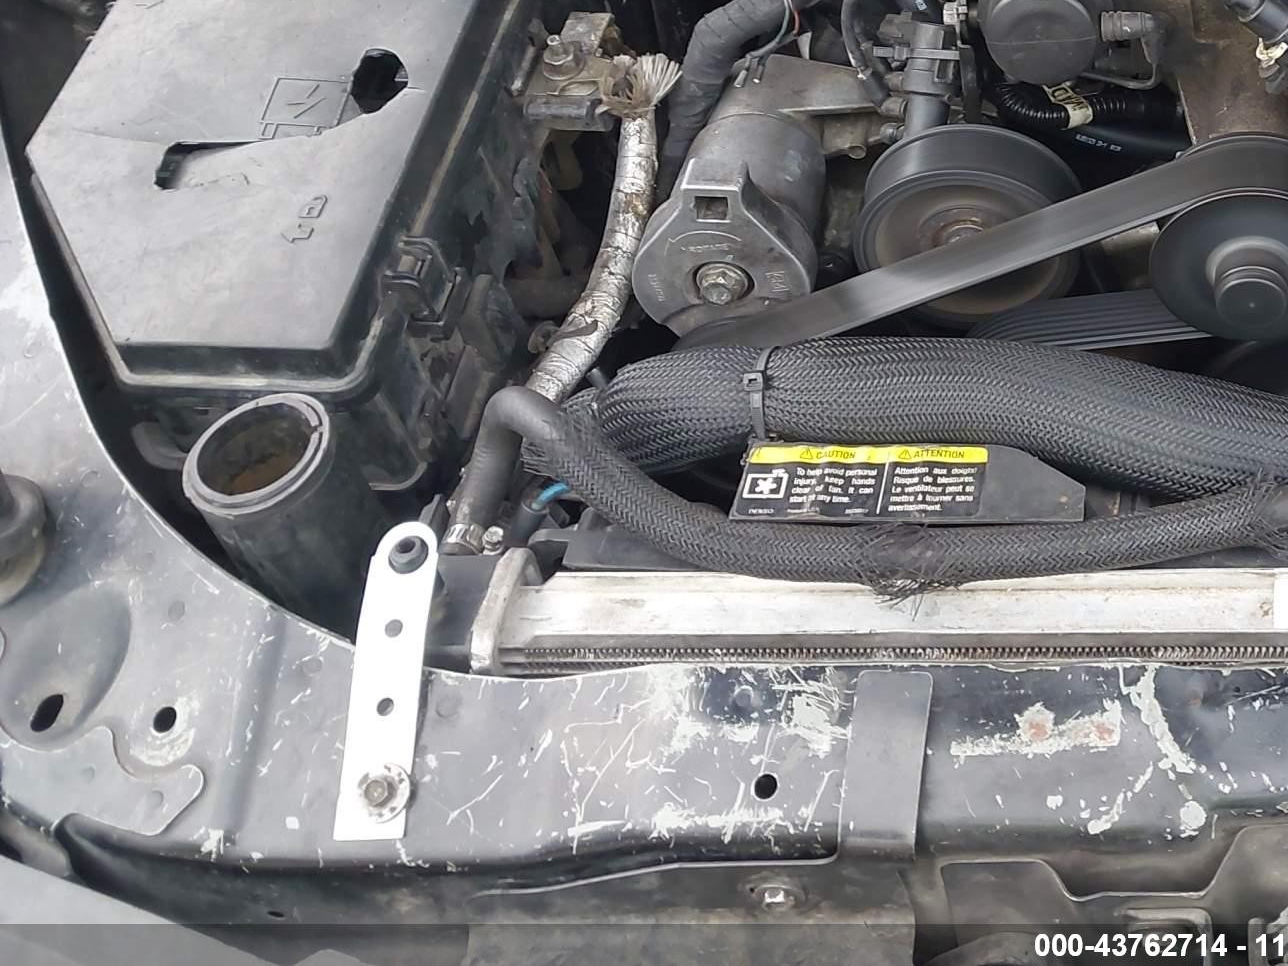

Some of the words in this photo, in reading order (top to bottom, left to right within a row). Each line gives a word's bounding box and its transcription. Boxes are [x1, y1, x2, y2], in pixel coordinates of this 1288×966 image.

[815, 450, 857, 460] CAUTION
[912, 449, 966, 459] ATTENTION
[796, 467, 806, 476] To
[806, 468, 823, 477] help
[823, 468, 845, 476] avoid
[845, 468, 878, 477] personal
[894, 466, 929, 475] Attention
[932, 467, 948, 475] aux
[824, 476, 845, 486] keep
[851, 477, 876, 485] hands
[893, 476, 920, 485] Risque
[922, 475, 934, 483] de
[937, 476, 976, 484] blessures.
[791, 486, 812, 494] clear
[814, 484, 824, 492] of
[828, 485, 844, 494] fan.
[858, 486, 874, 494] can
[891, 485, 902, 493] Le
[904, 484, 943, 493] ventilateur
[945, 485, 963, 494] peut
[965, 485, 975, 493] se
[789, 495, 807, 503] start
[807, 494, 816, 502] at
[816, 494, 831, 503] any
[831, 495, 852, 503] time.
[925, 494, 954, 502] tourner
[888, 504, 943, 512] avertissement.
